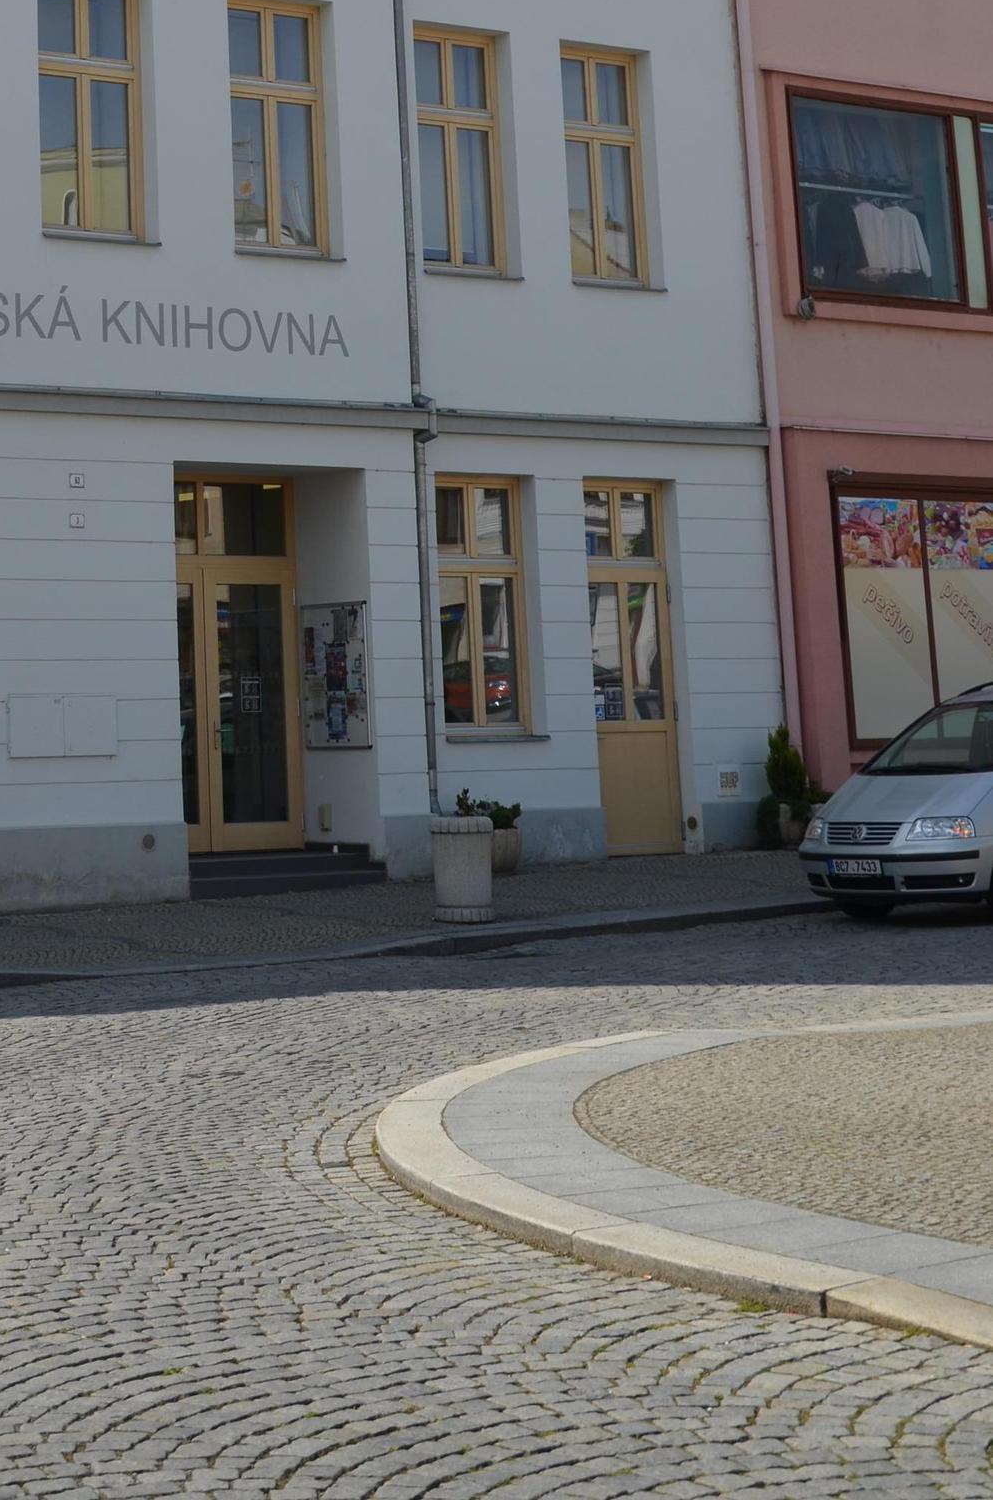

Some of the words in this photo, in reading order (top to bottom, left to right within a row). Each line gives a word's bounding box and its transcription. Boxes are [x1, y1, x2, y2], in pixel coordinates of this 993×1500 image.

[100, 298, 350, 358] KNIHOVNA
[863, 583, 915, 644] pečivo
[854, 860, 878, 873] 7433
